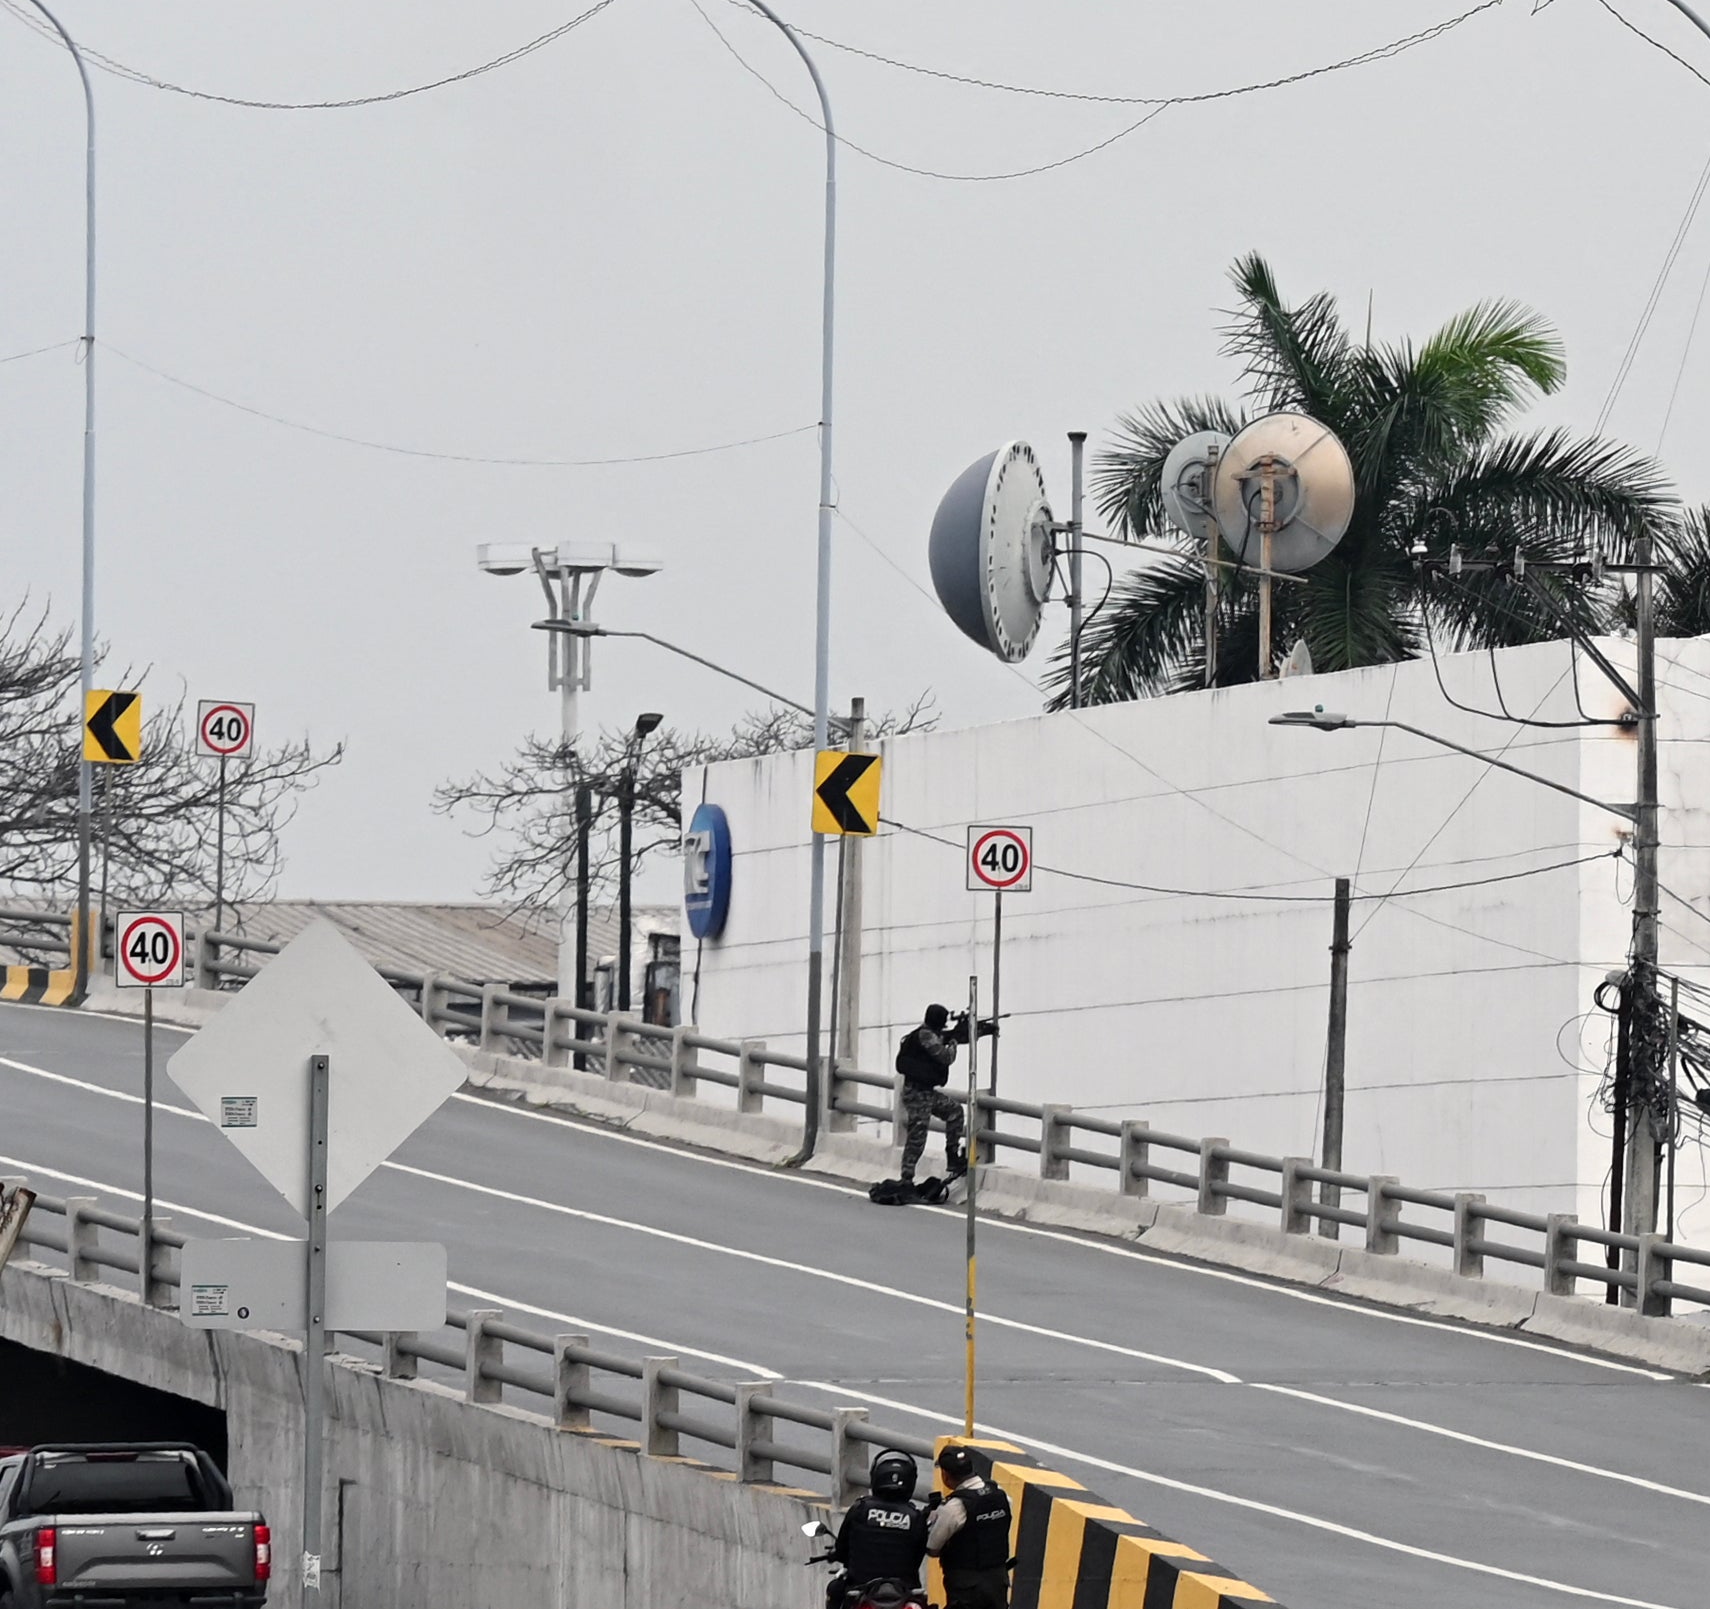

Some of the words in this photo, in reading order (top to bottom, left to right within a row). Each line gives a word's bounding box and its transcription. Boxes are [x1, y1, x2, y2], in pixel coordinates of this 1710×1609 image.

[209, 717, 242, 742] 40
[981, 843, 1019, 873] 40
[129, 931, 169, 964] 40
